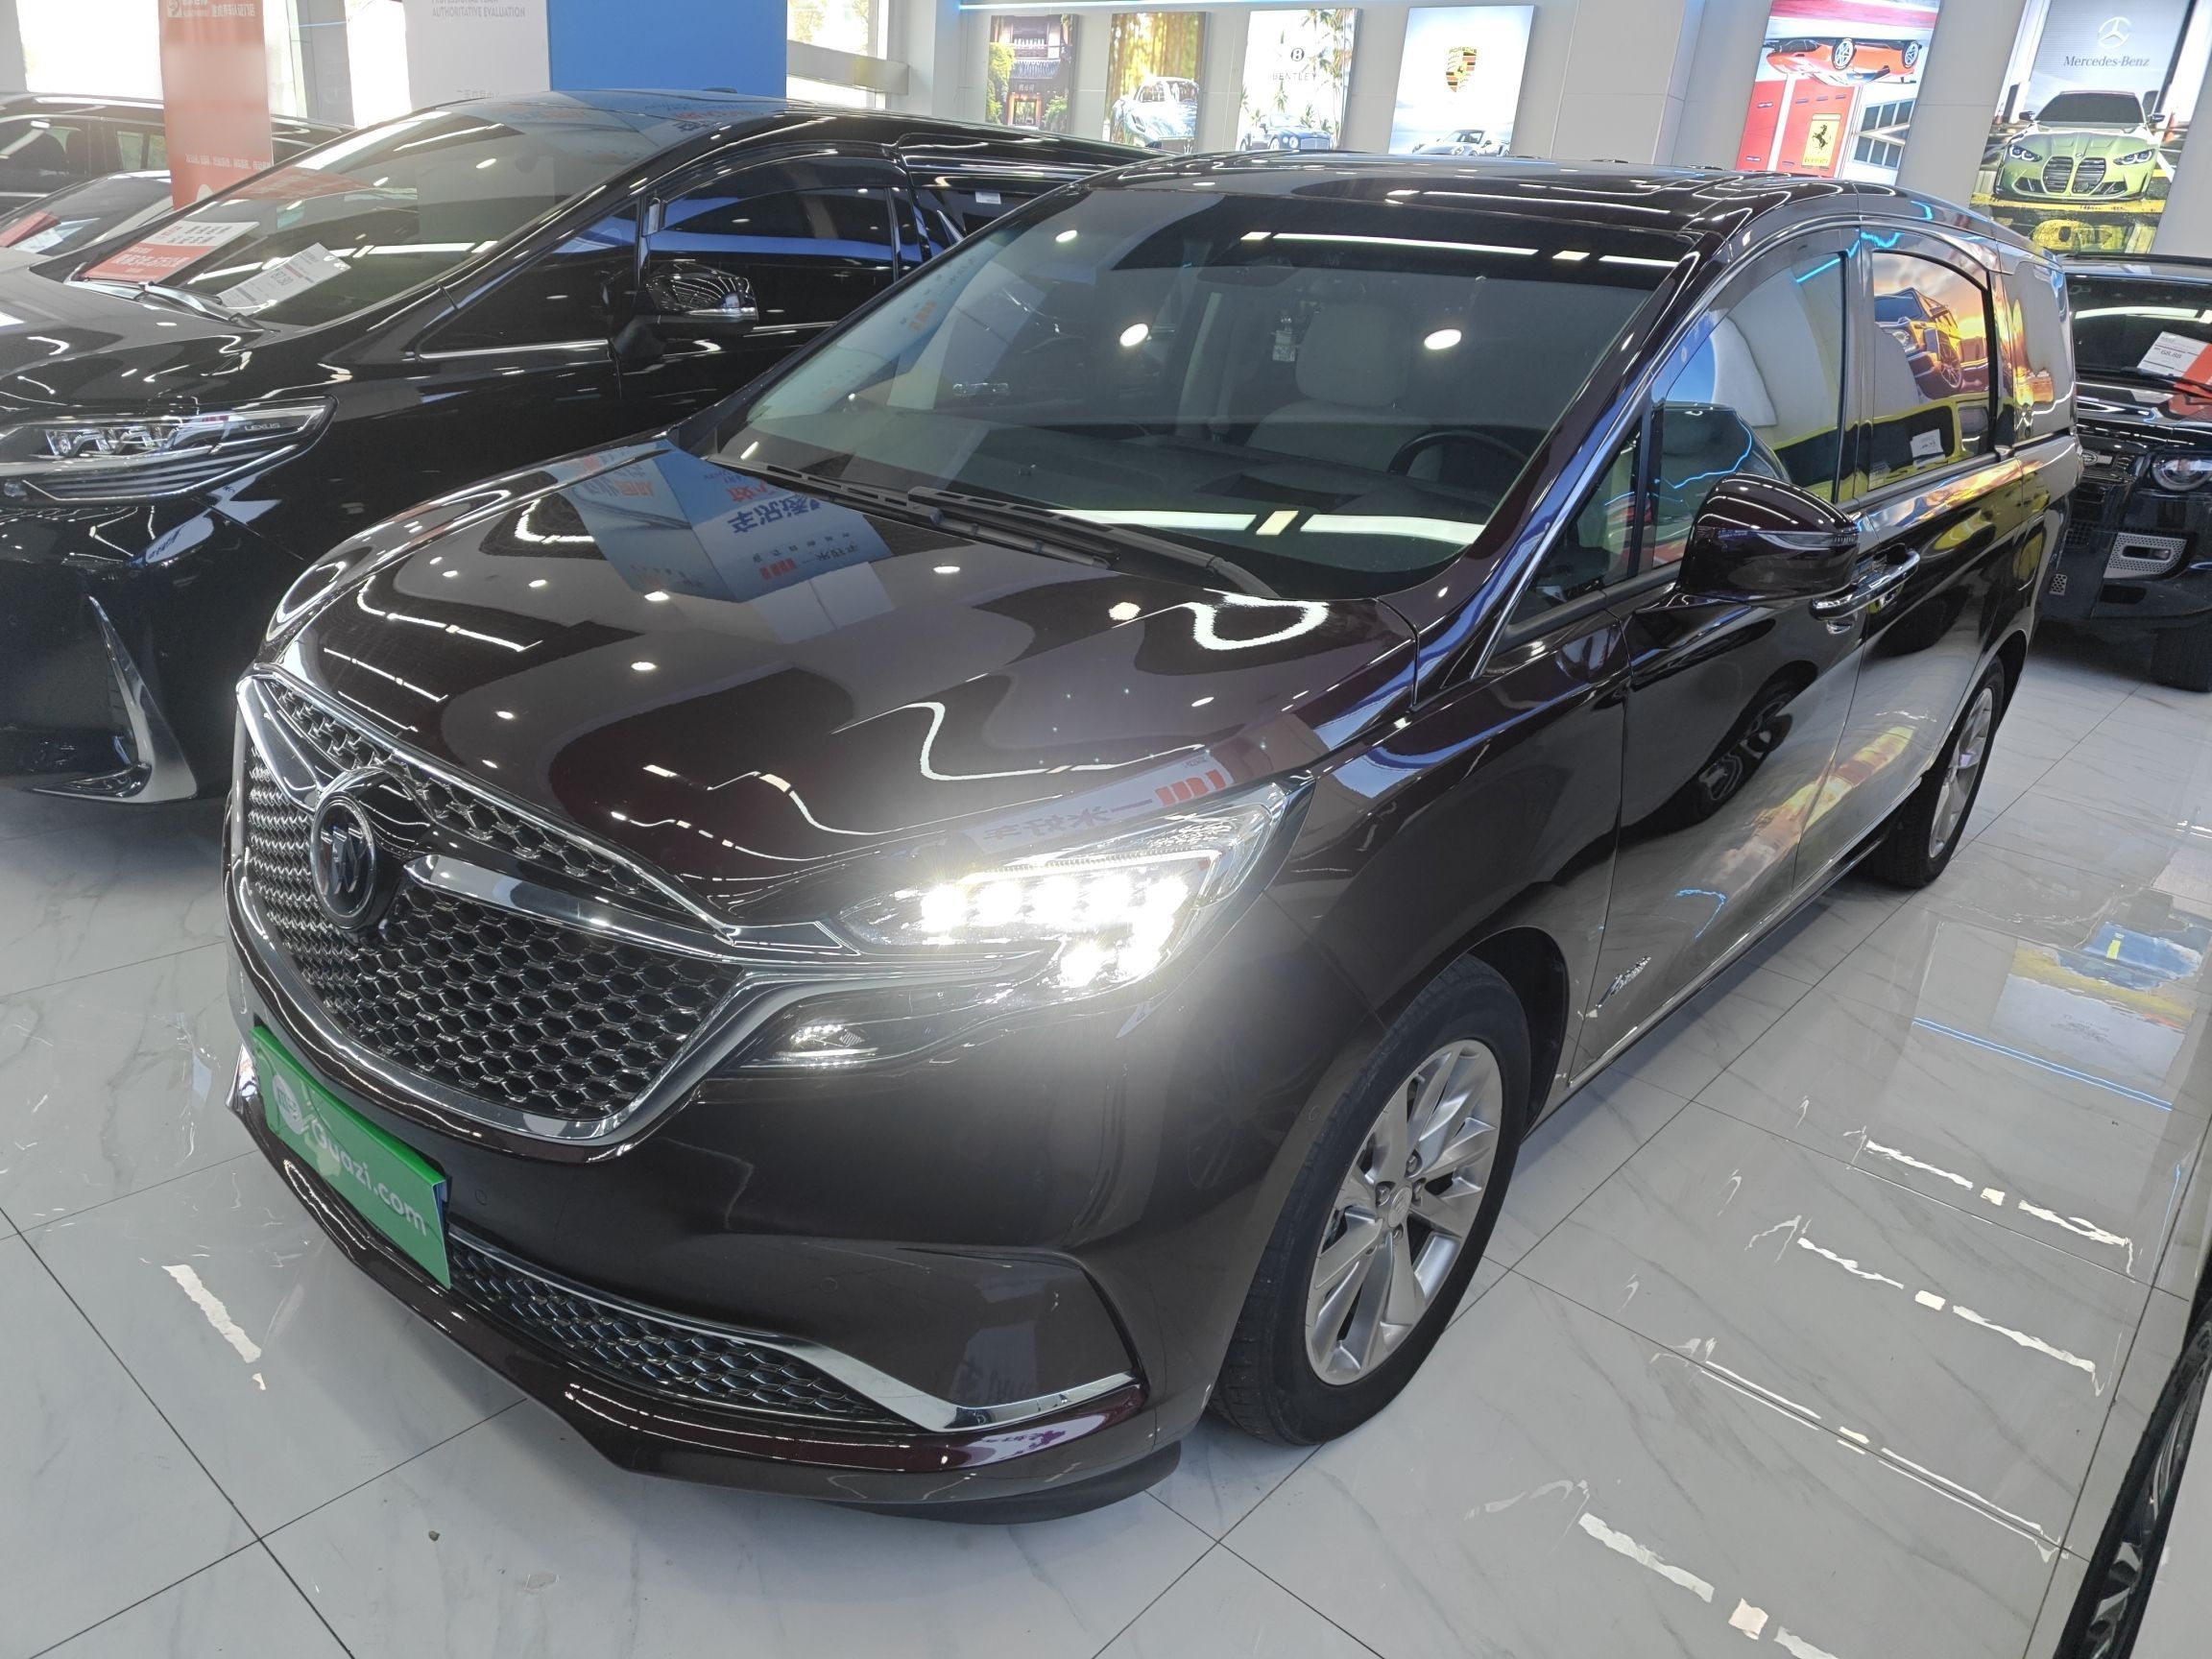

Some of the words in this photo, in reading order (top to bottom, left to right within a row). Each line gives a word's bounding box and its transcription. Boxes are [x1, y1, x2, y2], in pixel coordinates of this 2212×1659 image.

[432, 6, 482, 17] AUTHORITATIVE
[483, 6, 526, 17] EVALUATION
[2063, 56, 2151, 67] Mercedes-Benz
[1272, 71, 1317, 81] BENTLEY
[244, 422, 281, 432] LEXUS
[311, 1117, 427, 1238] Guazi.com
